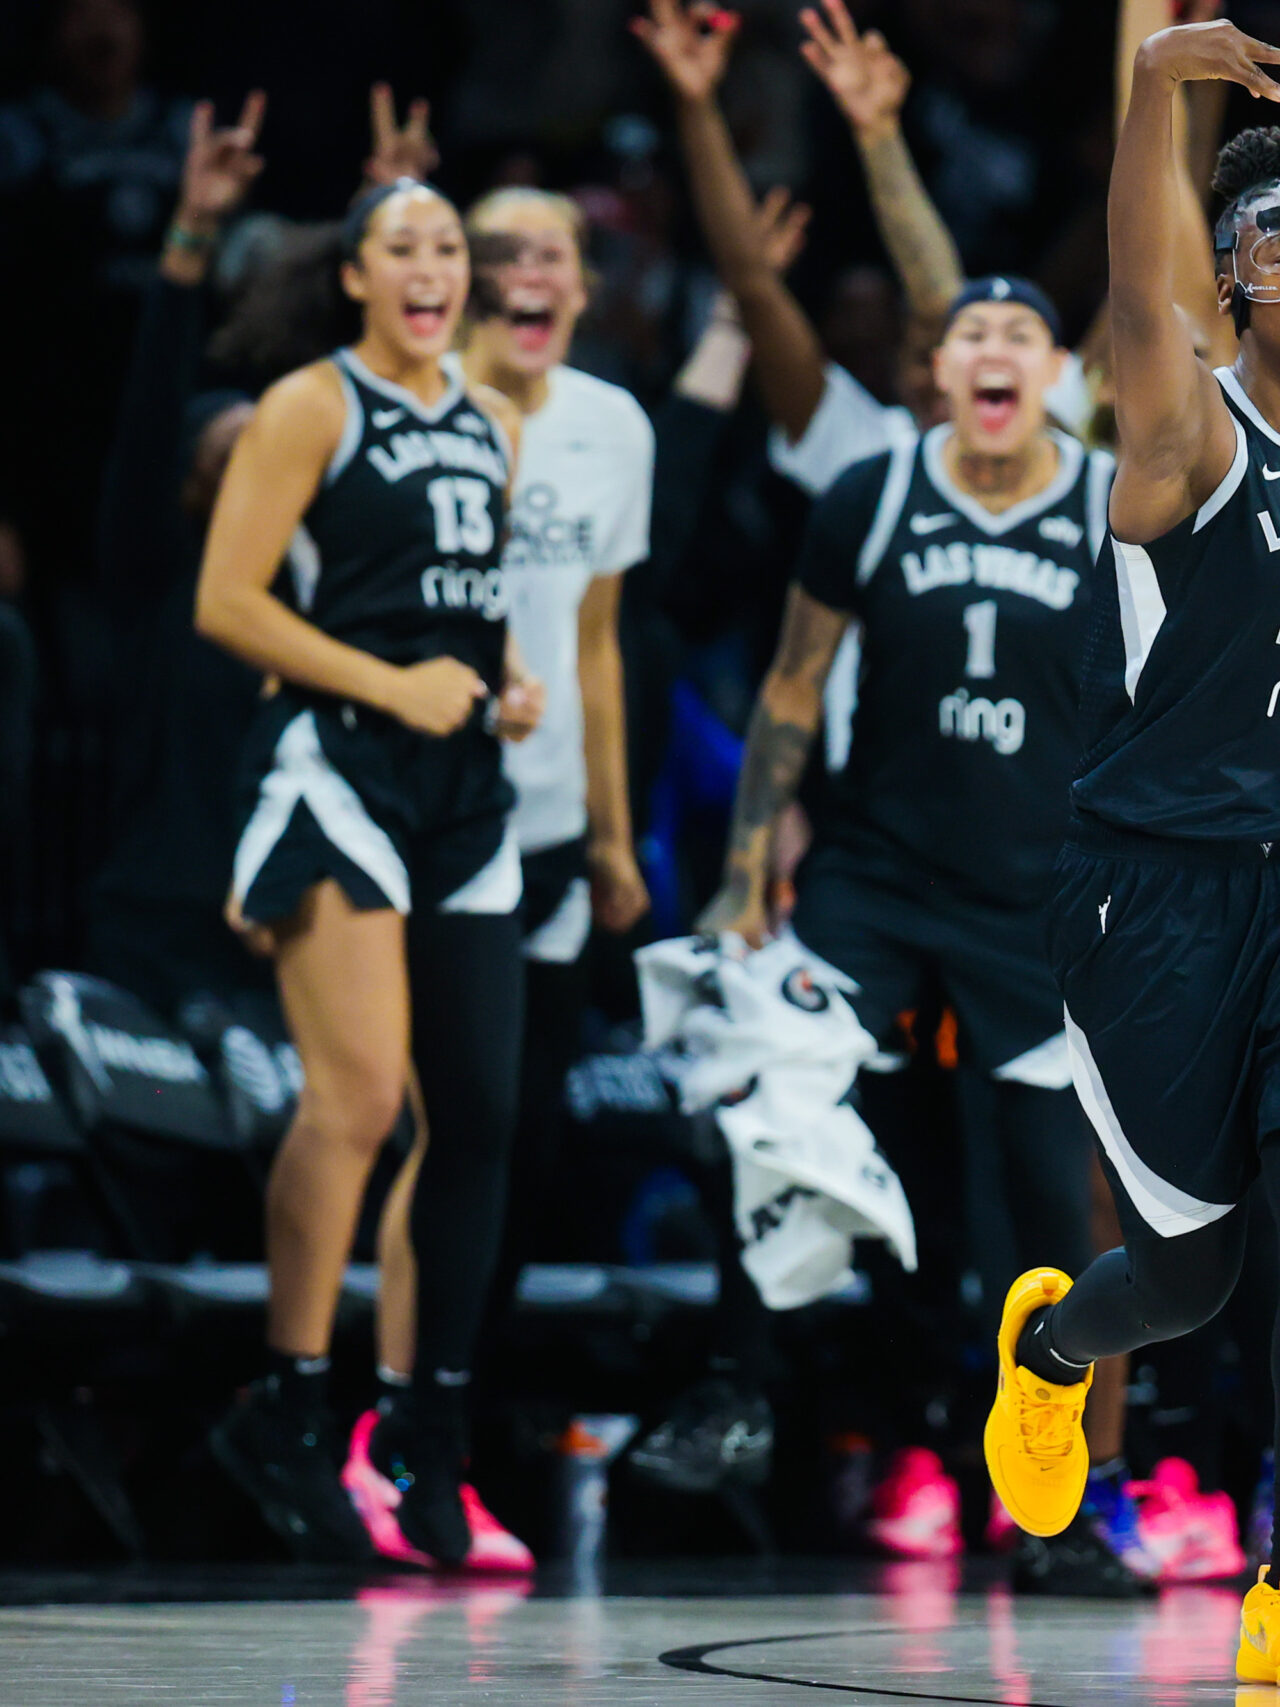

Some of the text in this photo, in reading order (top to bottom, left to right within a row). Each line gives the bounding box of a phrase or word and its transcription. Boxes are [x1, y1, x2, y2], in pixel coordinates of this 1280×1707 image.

[427, 476, 494, 554] 13
[420, 559, 508, 622] ring
[901, 541, 1080, 611] LAS VEGAS
[963, 599, 998, 679] 1
[938, 687, 1026, 755] ring
